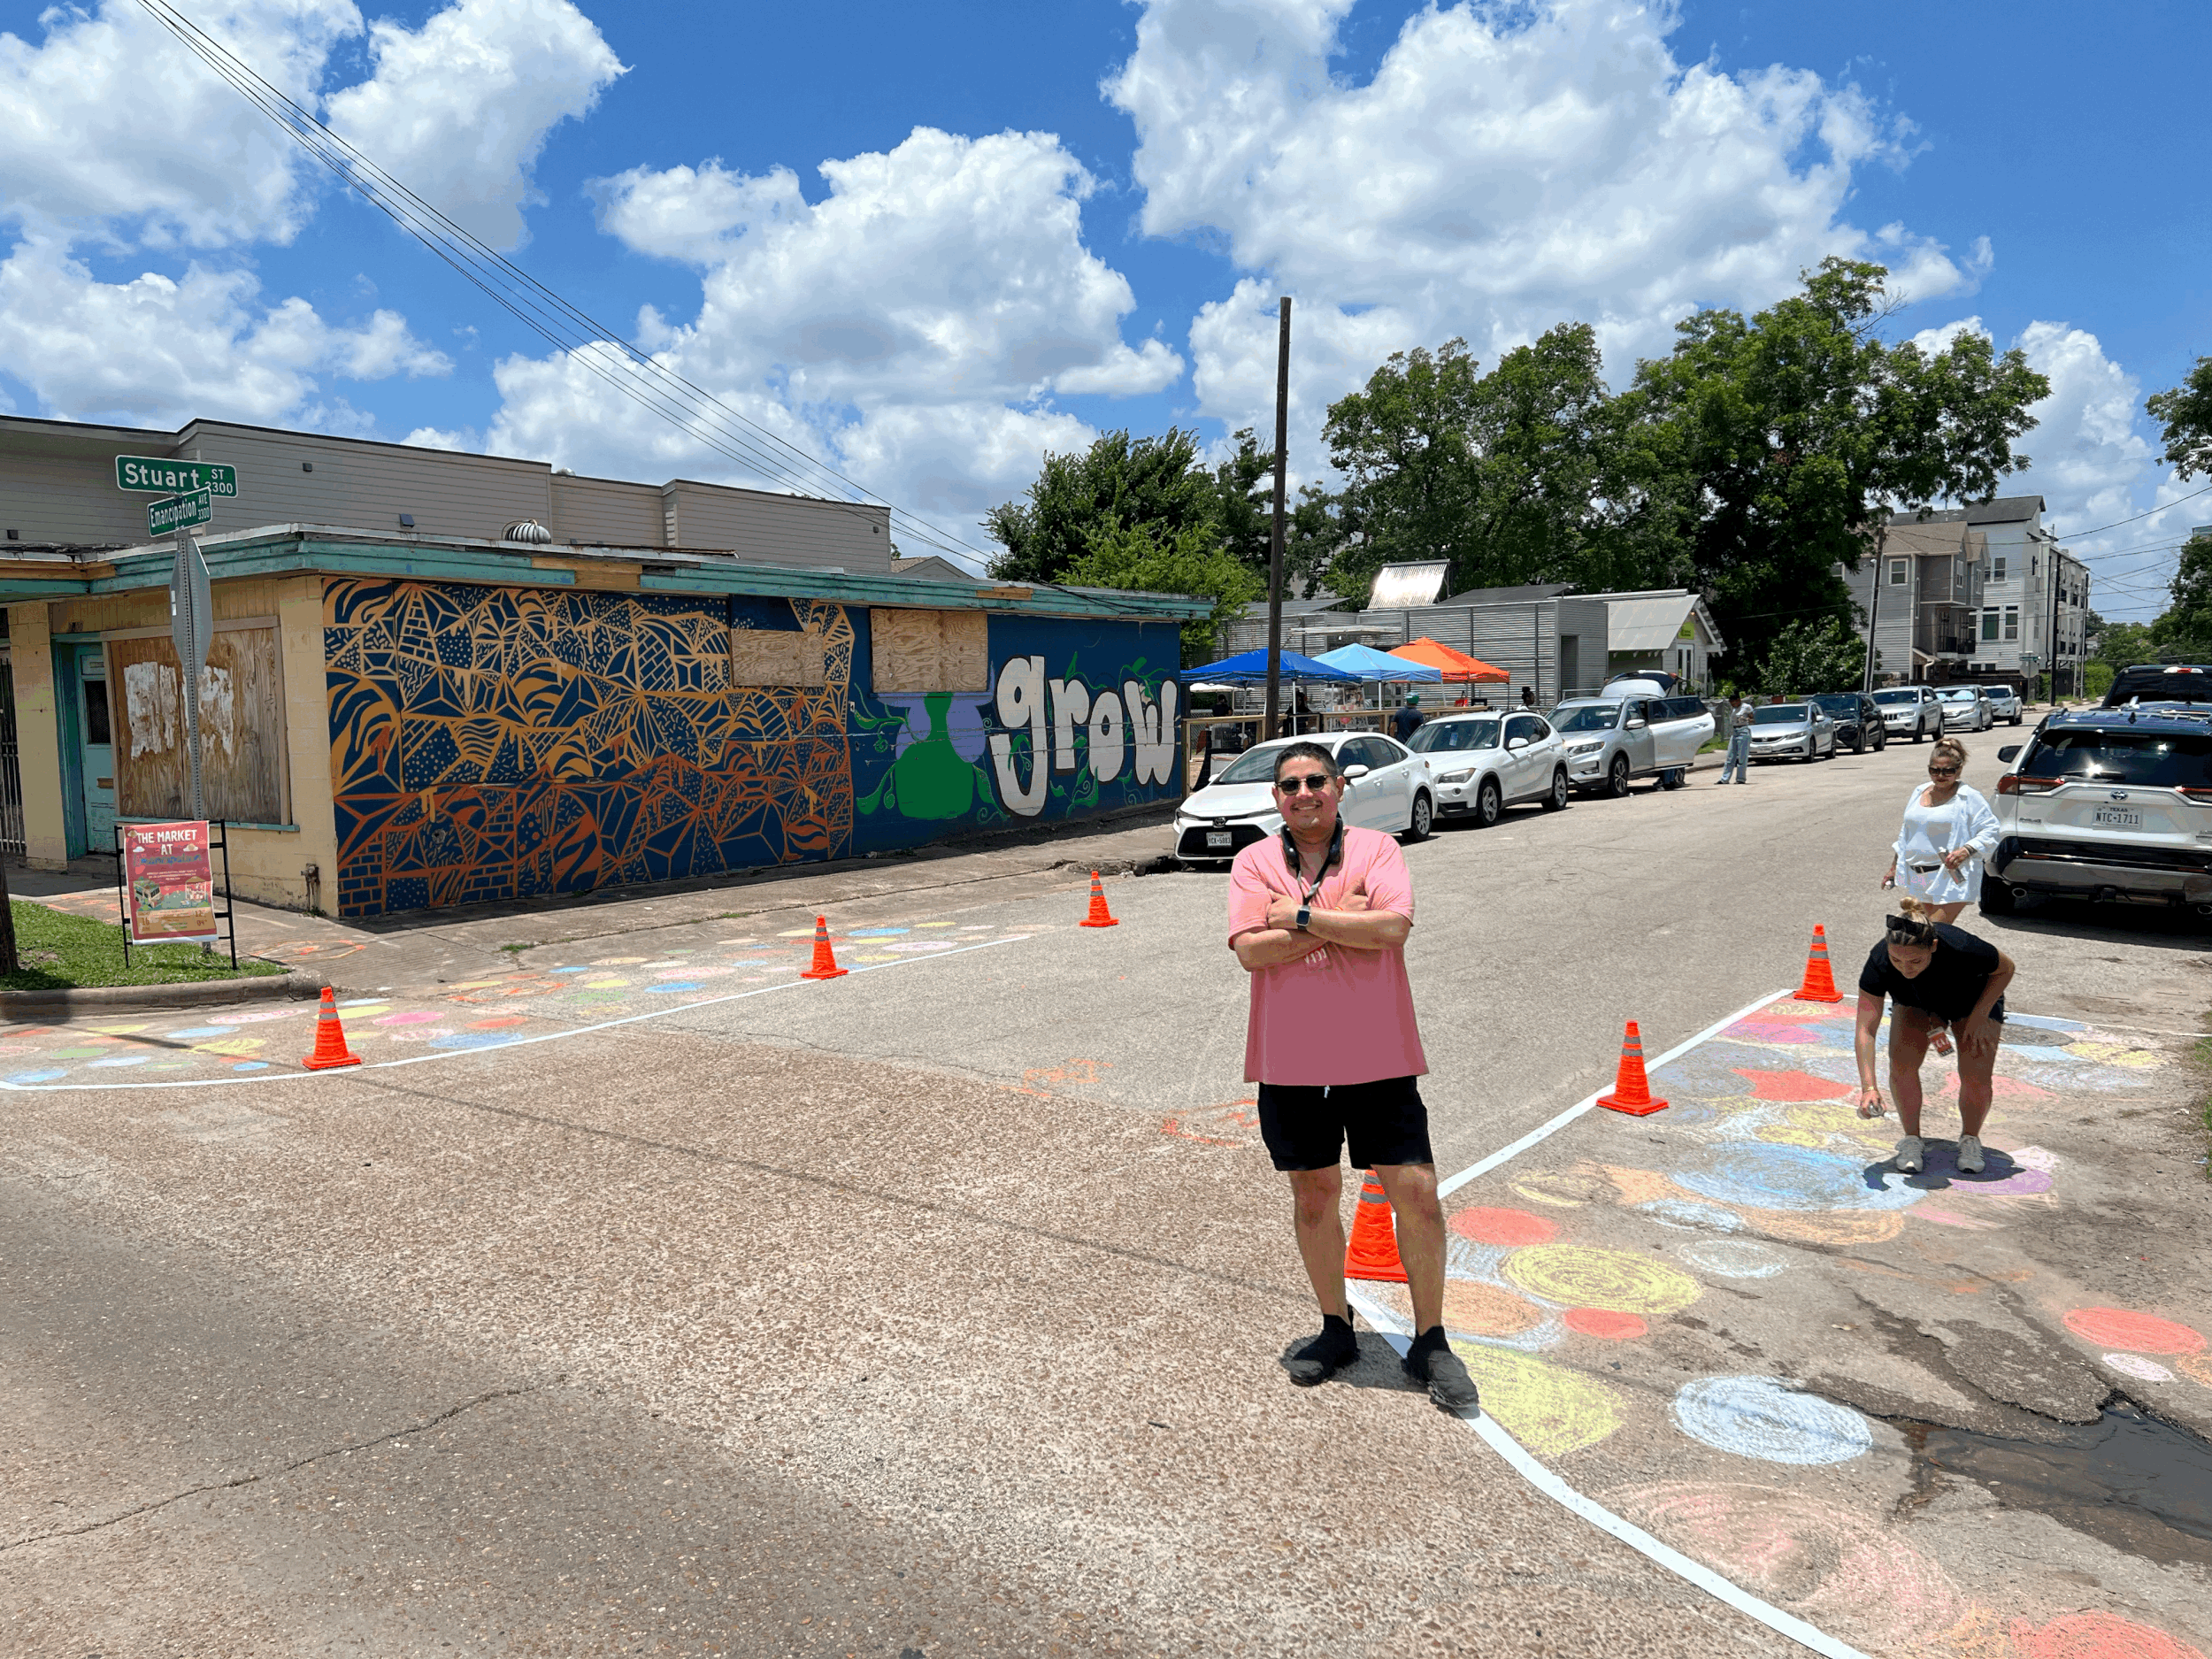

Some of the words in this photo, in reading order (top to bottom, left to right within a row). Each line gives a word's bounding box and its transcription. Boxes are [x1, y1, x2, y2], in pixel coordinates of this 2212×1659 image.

[125, 463, 200, 489] Stuart
[211, 468, 225, 480] ST
[150, 497, 197, 528] Emancipation
[198, 492, 208, 506] AVE
[989, 655, 1178, 817] grow
[136, 832, 155, 844] THE
[157, 829, 198, 843] MARKET
[160, 843, 173, 856] AT
